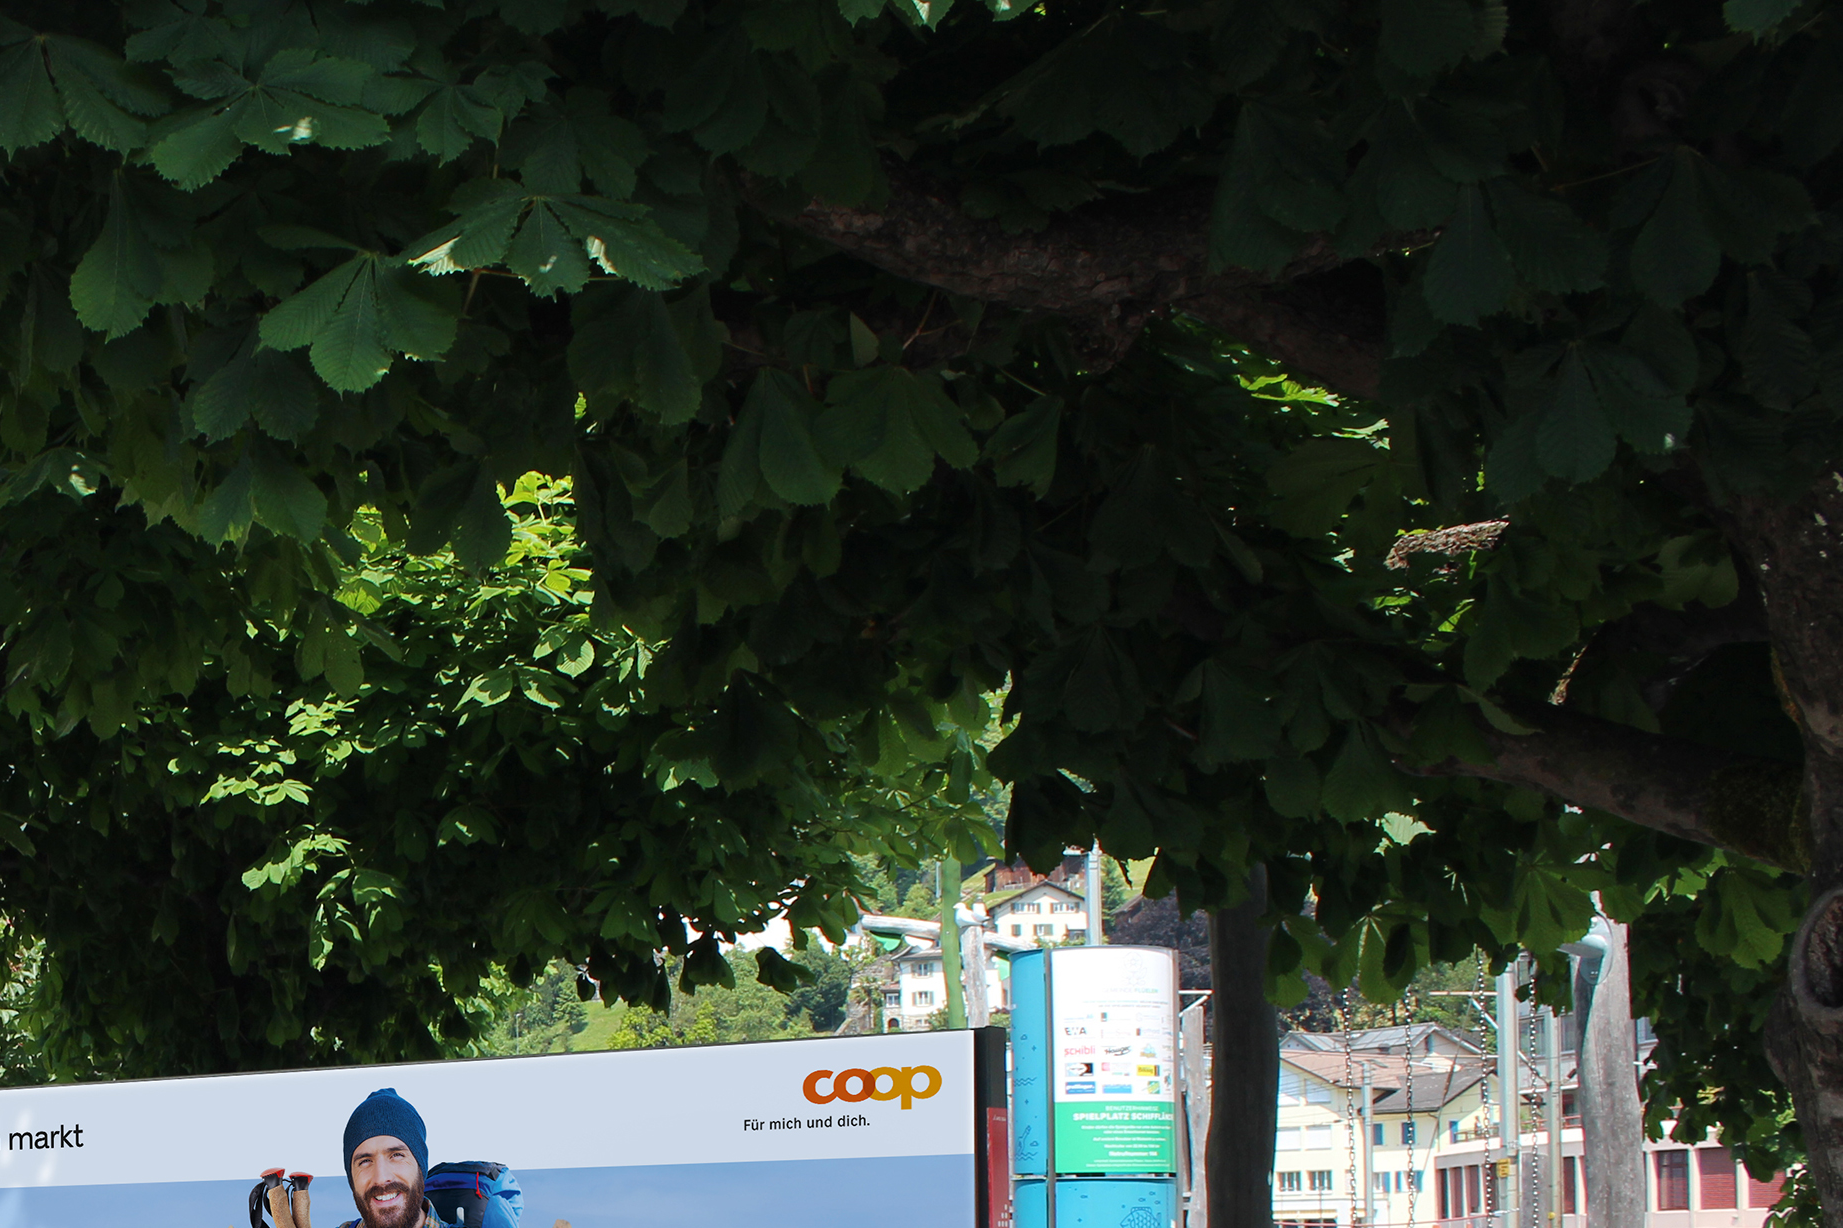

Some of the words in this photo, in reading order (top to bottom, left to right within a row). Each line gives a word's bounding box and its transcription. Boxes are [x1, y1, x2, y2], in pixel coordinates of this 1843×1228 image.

[802, 1065, 943, 1110] coop
[743, 1119, 765, 1131] Für
[769, 1117, 802, 1130] mich
[807, 1115, 833, 1129] und
[837, 1114, 871, 1127] dich.
[1072, 1112, 1130, 1121] SPIELPLATZ
[9, 1124, 84, 1150] markt
